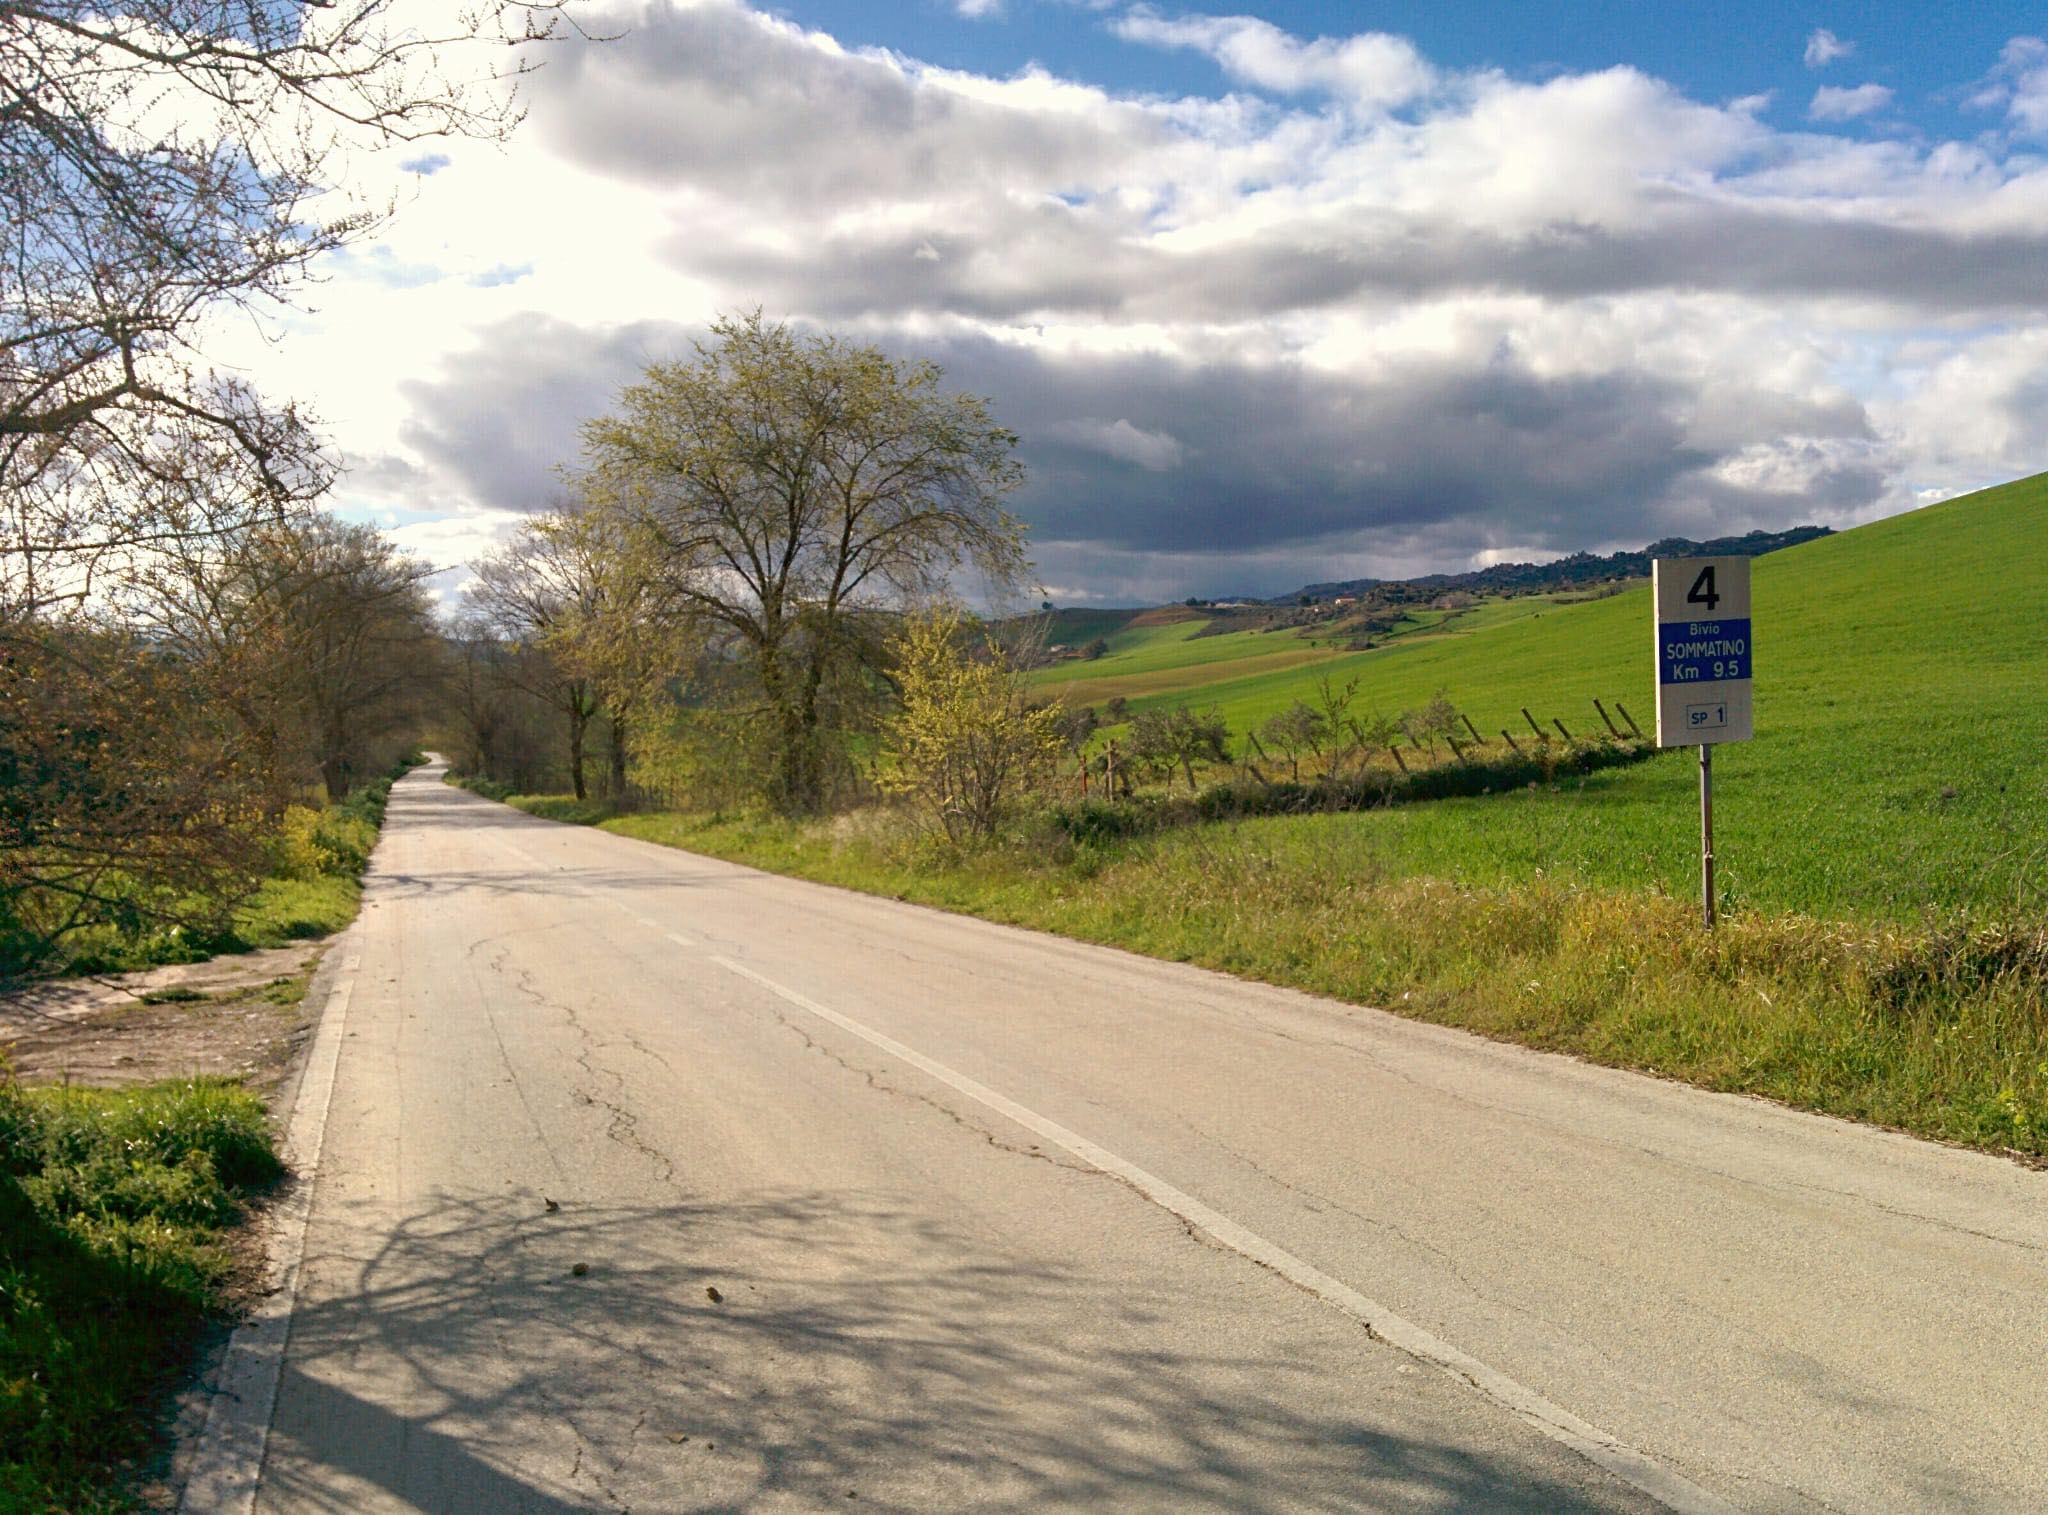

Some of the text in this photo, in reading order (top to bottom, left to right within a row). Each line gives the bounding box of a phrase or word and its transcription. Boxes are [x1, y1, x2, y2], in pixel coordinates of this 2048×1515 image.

[1687, 566, 1720, 611] 4
[1690, 623, 1719, 636] Bivio
[1667, 639, 1745, 660] SOMMATINO
[1673, 664, 1699, 680] Km
[1691, 706, 1724, 725] SP 1
